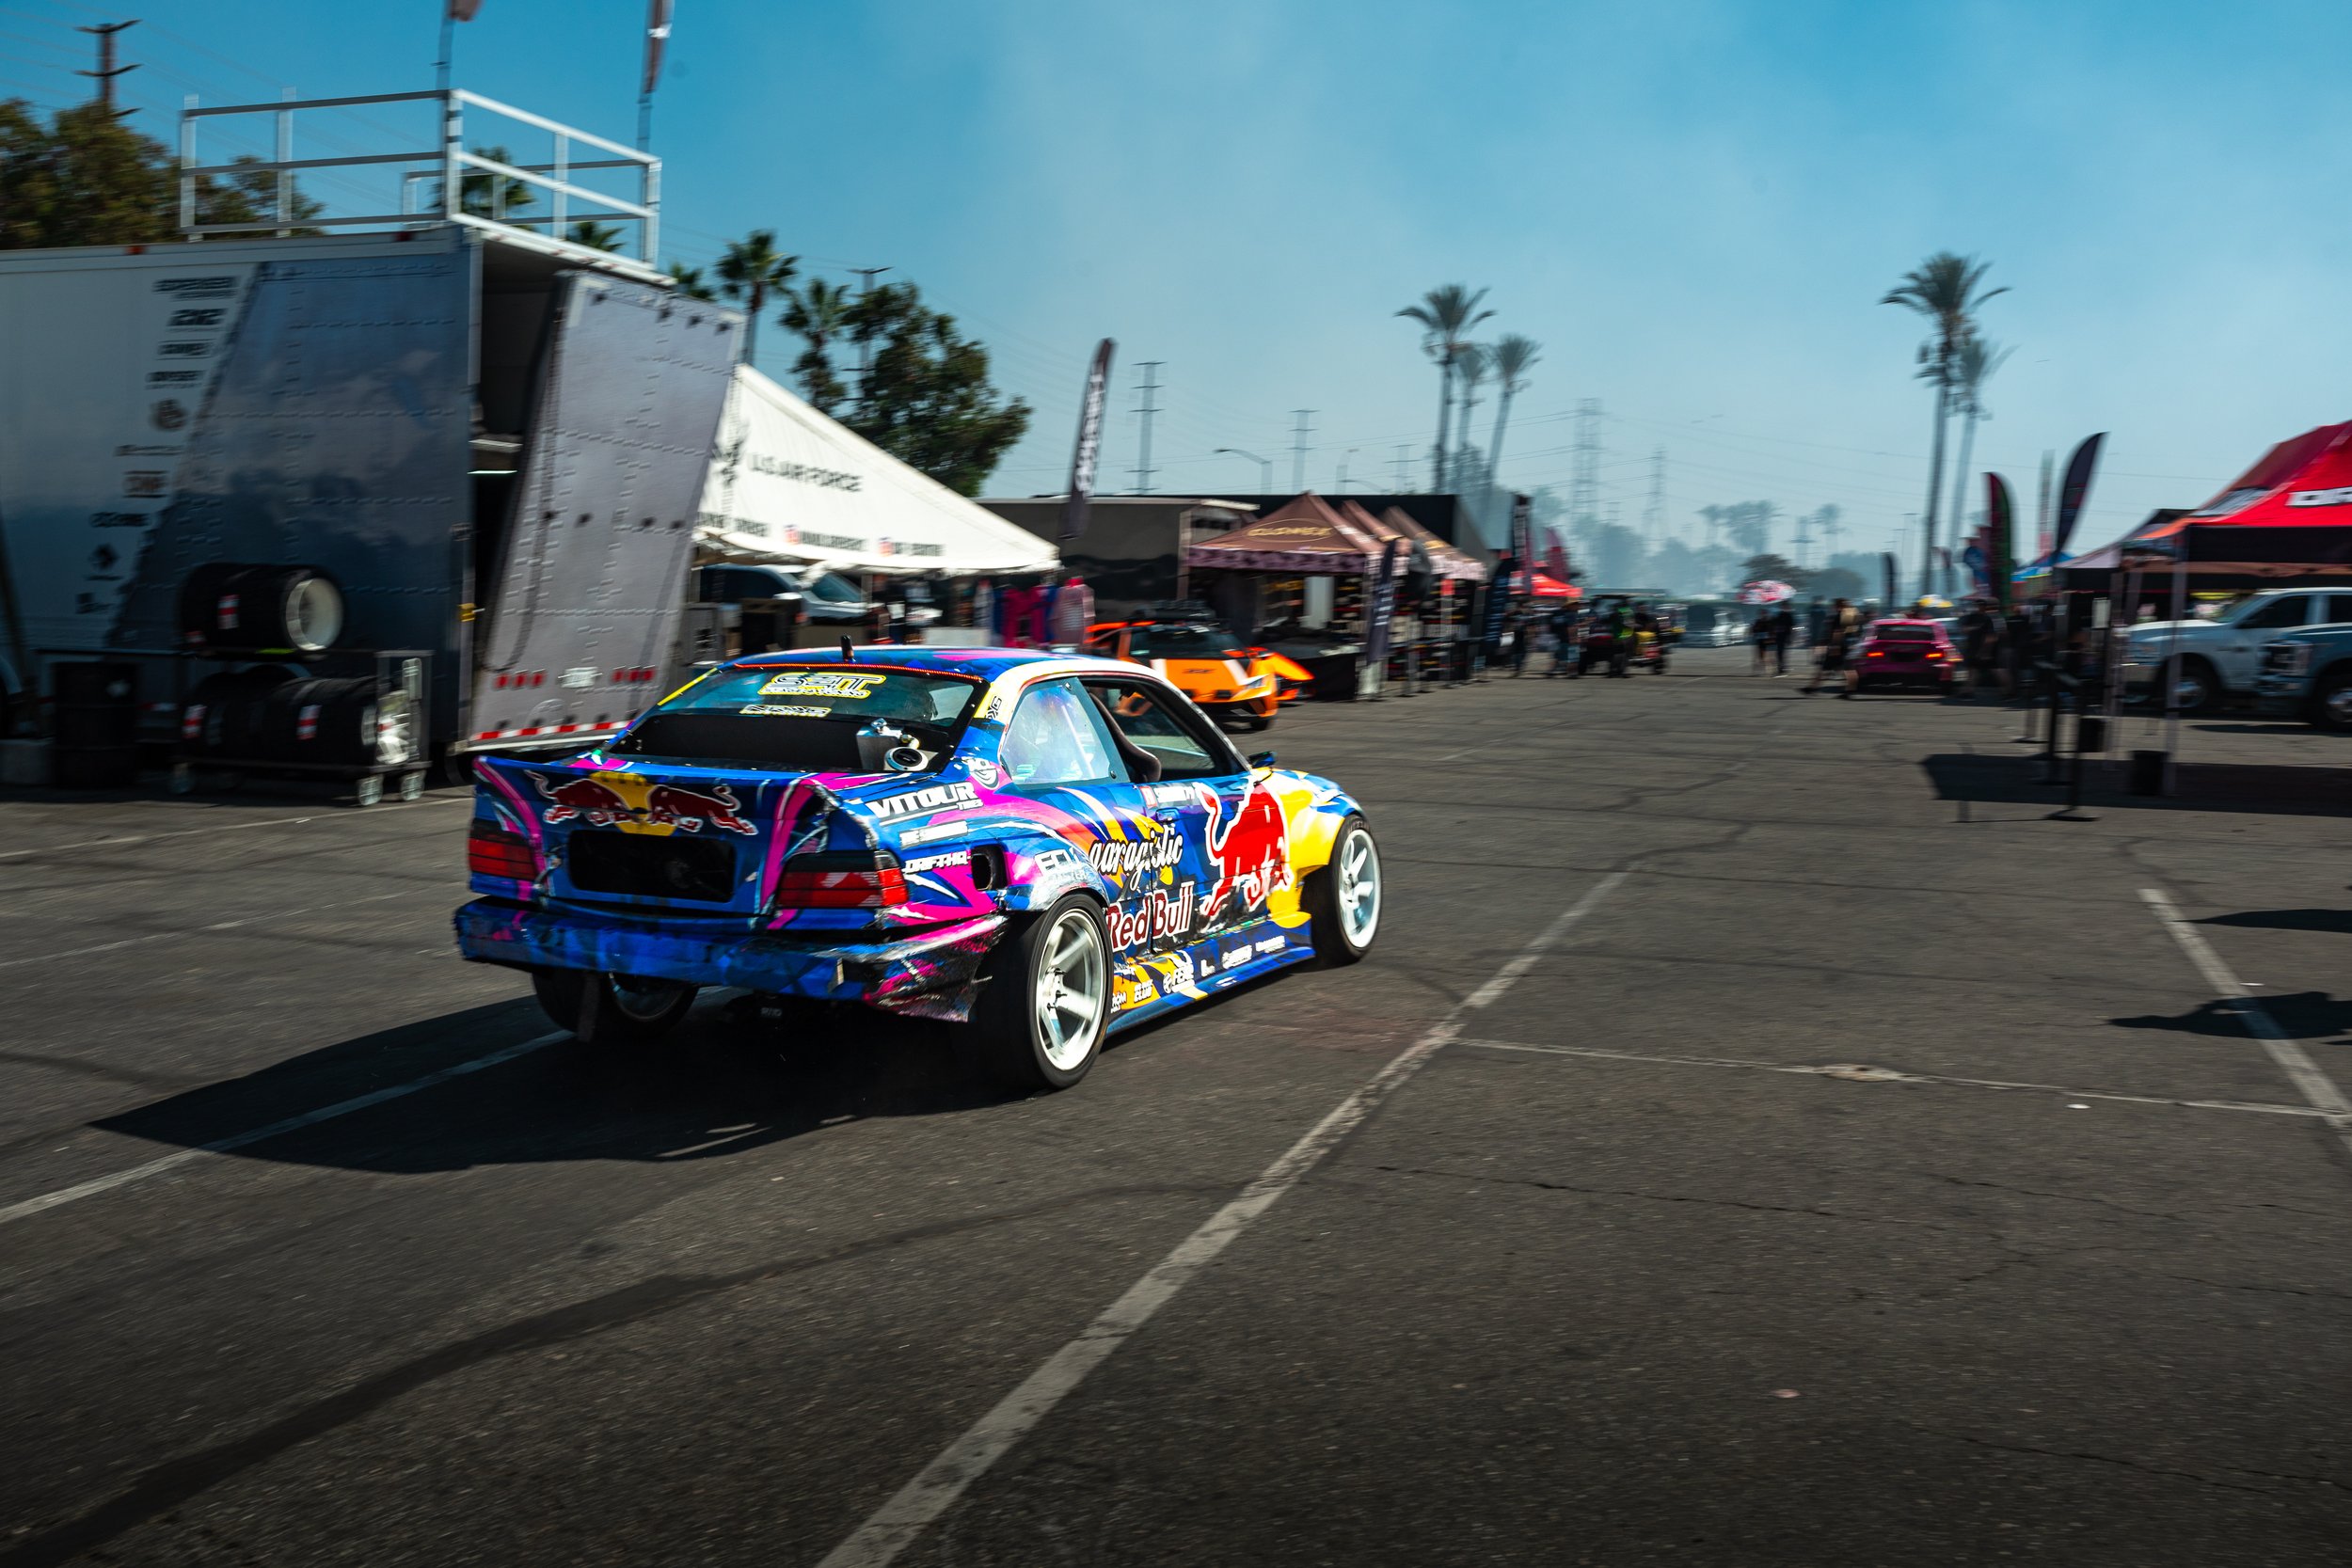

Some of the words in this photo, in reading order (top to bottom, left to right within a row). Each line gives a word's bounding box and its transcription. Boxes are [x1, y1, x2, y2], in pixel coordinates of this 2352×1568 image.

[805, 467, 863, 493] FORCE
[865, 781, 979, 818] VITOUR
[1104, 892, 1153, 953] Red
[1152, 880, 1195, 940] Bull
